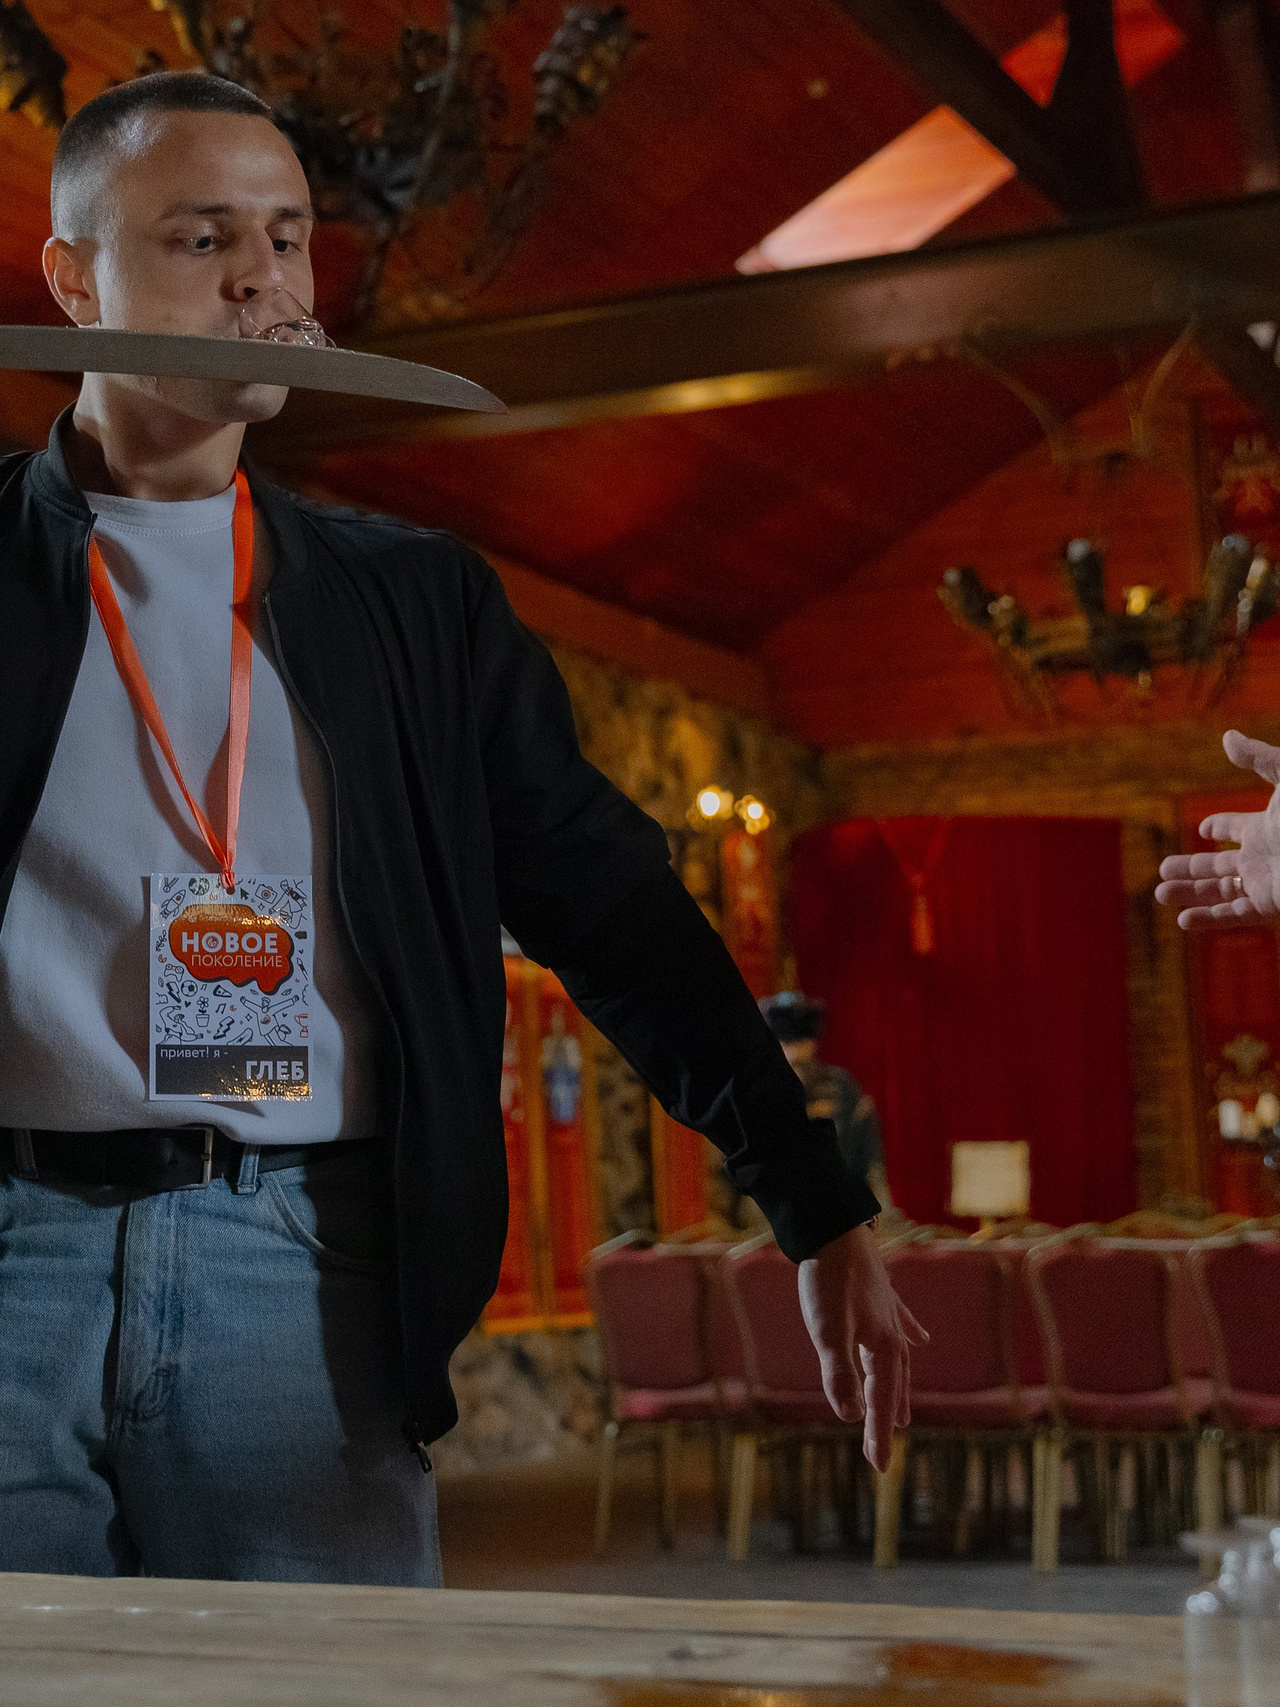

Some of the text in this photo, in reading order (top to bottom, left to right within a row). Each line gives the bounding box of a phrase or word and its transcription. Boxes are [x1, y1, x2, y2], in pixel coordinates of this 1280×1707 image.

[181, 931, 278, 953] НОВОЕ
[191, 954, 283, 968] ПОКОЛЕНИЕ
[160, 1046, 209, 1060] привет!
[213, 1049, 220, 1058] я
[245, 1060, 305, 1081] ГЛЕБ
